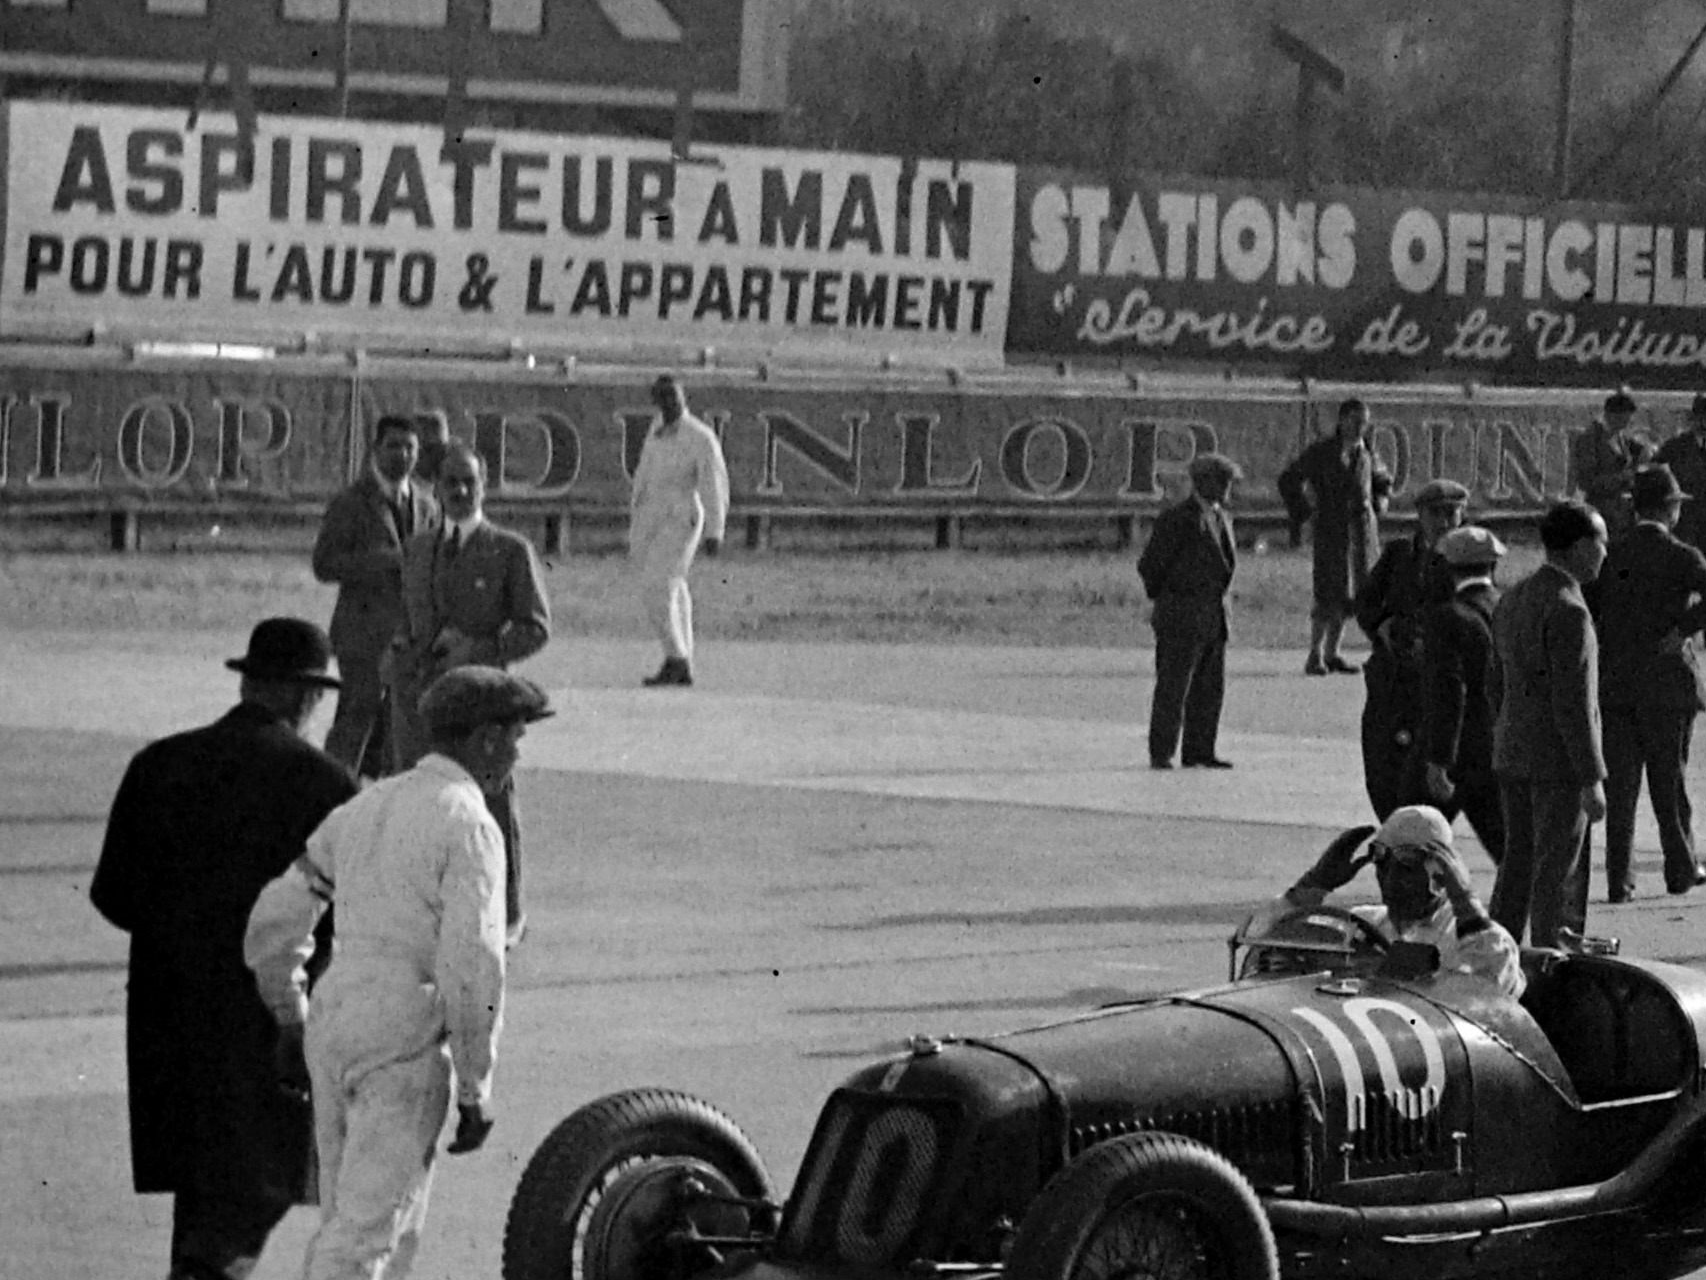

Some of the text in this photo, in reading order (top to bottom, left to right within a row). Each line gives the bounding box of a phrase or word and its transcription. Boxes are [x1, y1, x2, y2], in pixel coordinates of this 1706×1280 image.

[52, 125, 677, 241] ASPIRATEUR
[759, 167, 974, 262] MAIN
[1029, 183, 1356, 288] STATIONS
[24, 233, 994, 334] POUR L'AUTO & L'APPARTEMENT
[1353, 303, 1430, 355] de
[1443, 308, 1513, 360] la
[0, 390, 293, 489] LOP
[1290, 997, 1447, 1133] 10
[788, 1103, 939, 1264] 10
